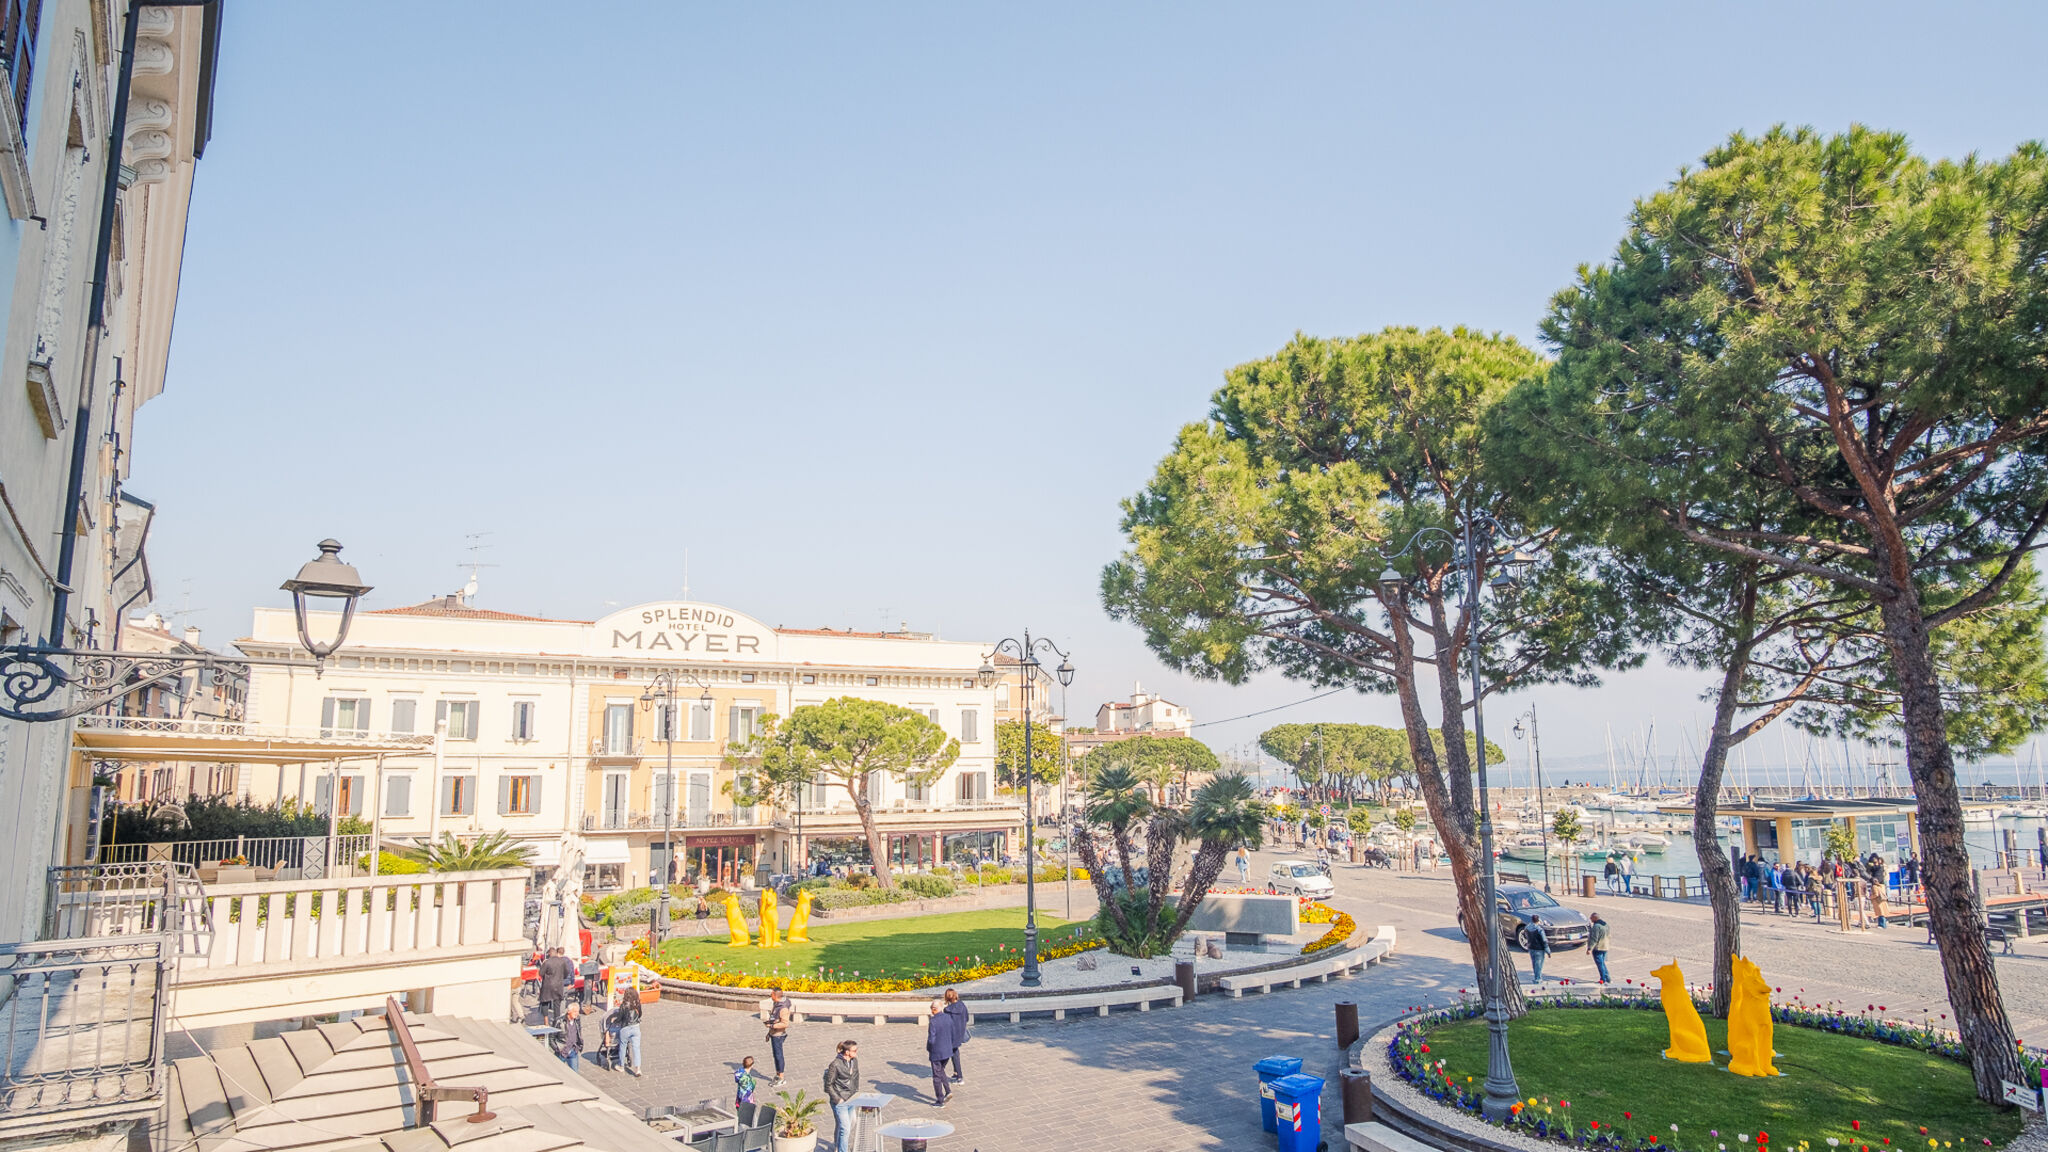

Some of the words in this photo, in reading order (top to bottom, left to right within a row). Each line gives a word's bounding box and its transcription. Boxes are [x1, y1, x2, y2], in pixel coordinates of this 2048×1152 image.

[642, 608, 735, 628] SPLENDID
[668, 623, 707, 631] HOTEL
[612, 630, 760, 653] MAYER
